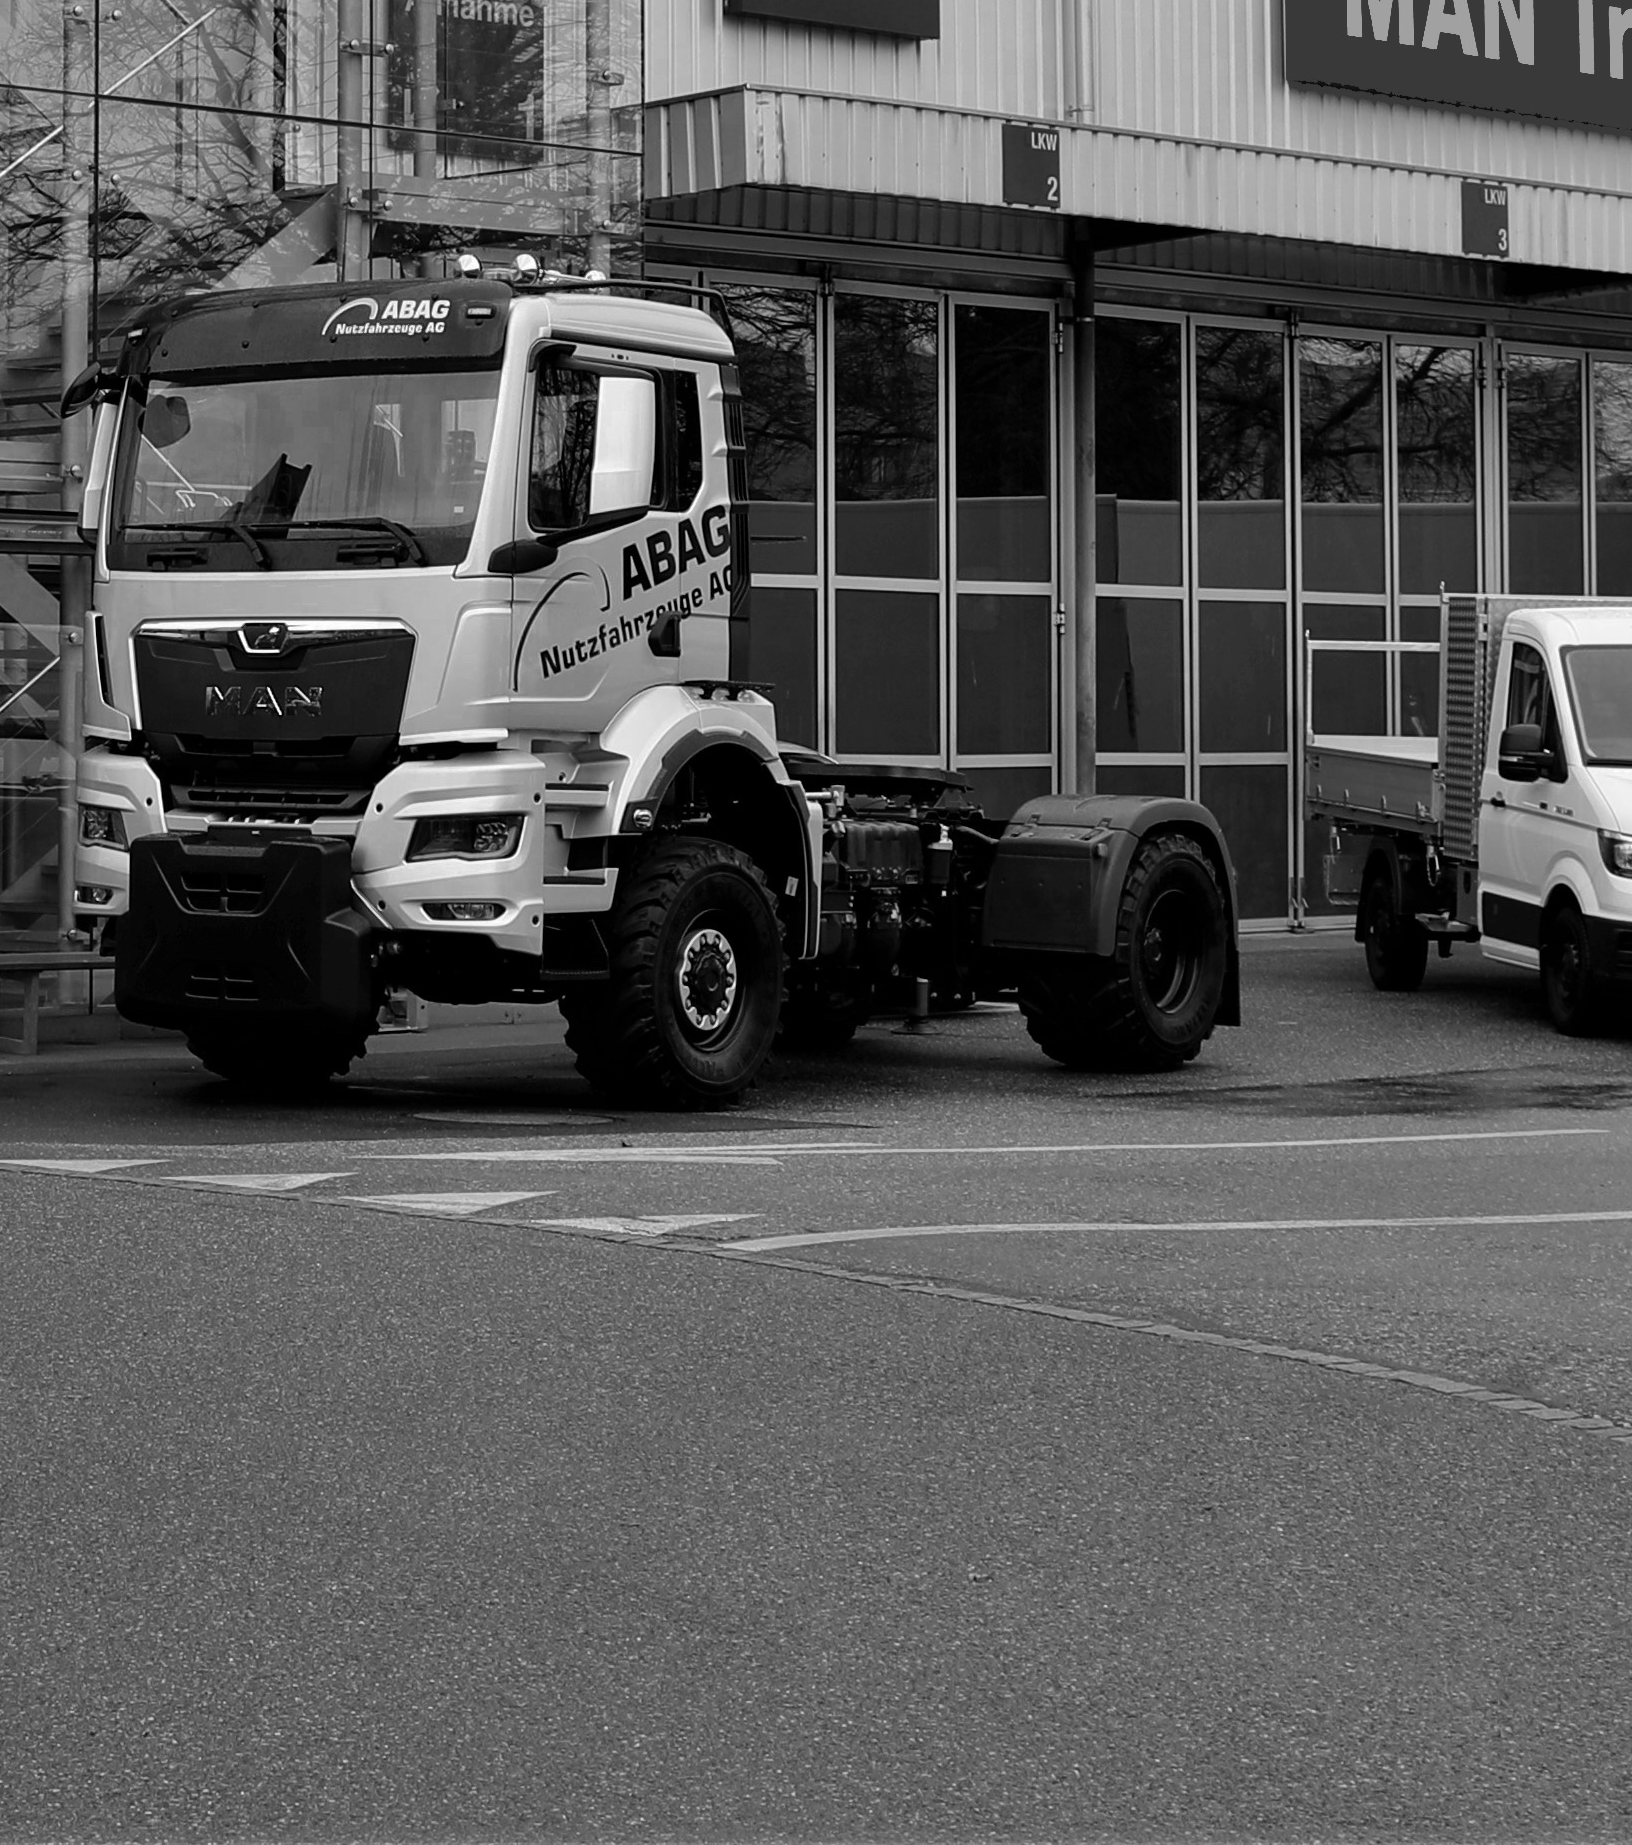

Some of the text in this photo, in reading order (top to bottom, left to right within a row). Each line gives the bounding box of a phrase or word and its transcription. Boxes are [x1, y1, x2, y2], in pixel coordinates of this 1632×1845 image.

[1030, 131, 1058, 153] LKW
[1046, 176, 1059, 202] 2
[1484, 187, 1507, 206] LKW
[1498, 228, 1508, 251] 3
[380, 299, 451, 320] ABAG
[335, 321, 445, 336] Nutzfahrzeuge AG
[622, 504, 732, 602] ABAG
[205, 685, 323, 717] MAN
